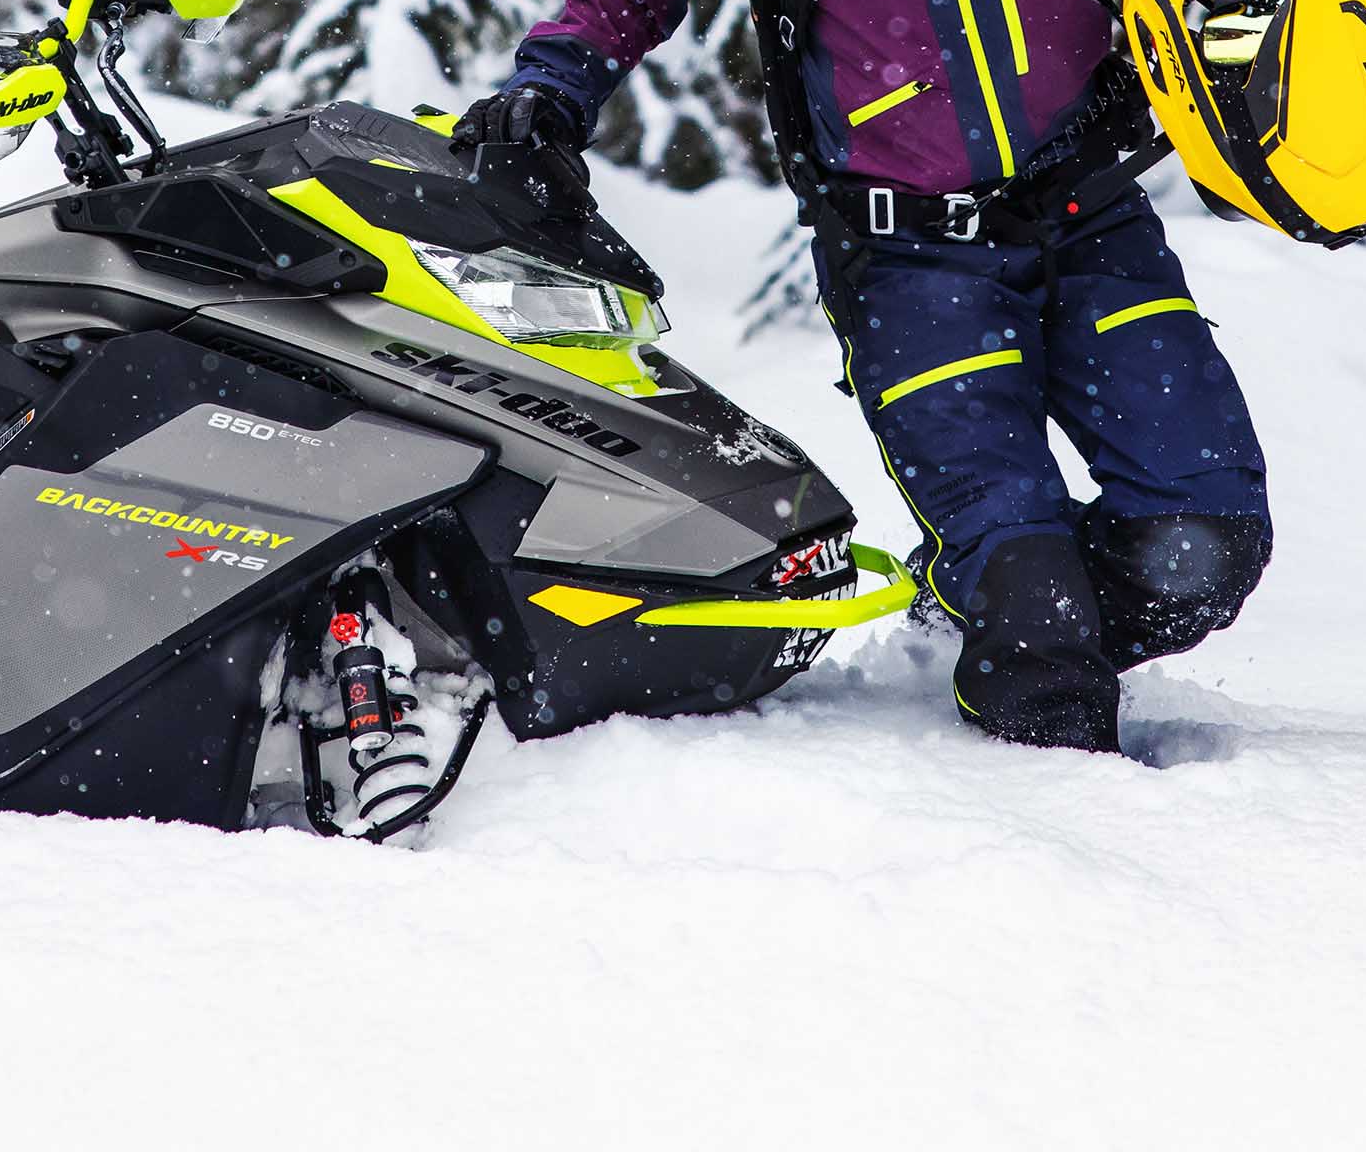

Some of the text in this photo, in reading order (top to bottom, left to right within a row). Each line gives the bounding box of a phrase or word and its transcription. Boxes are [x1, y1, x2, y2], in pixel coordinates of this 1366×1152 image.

[207, 412, 323, 447] 850 E-TEC
[370, 342, 642, 457] ski-doo
[35, 487, 294, 550] BACKCOUNTRY
